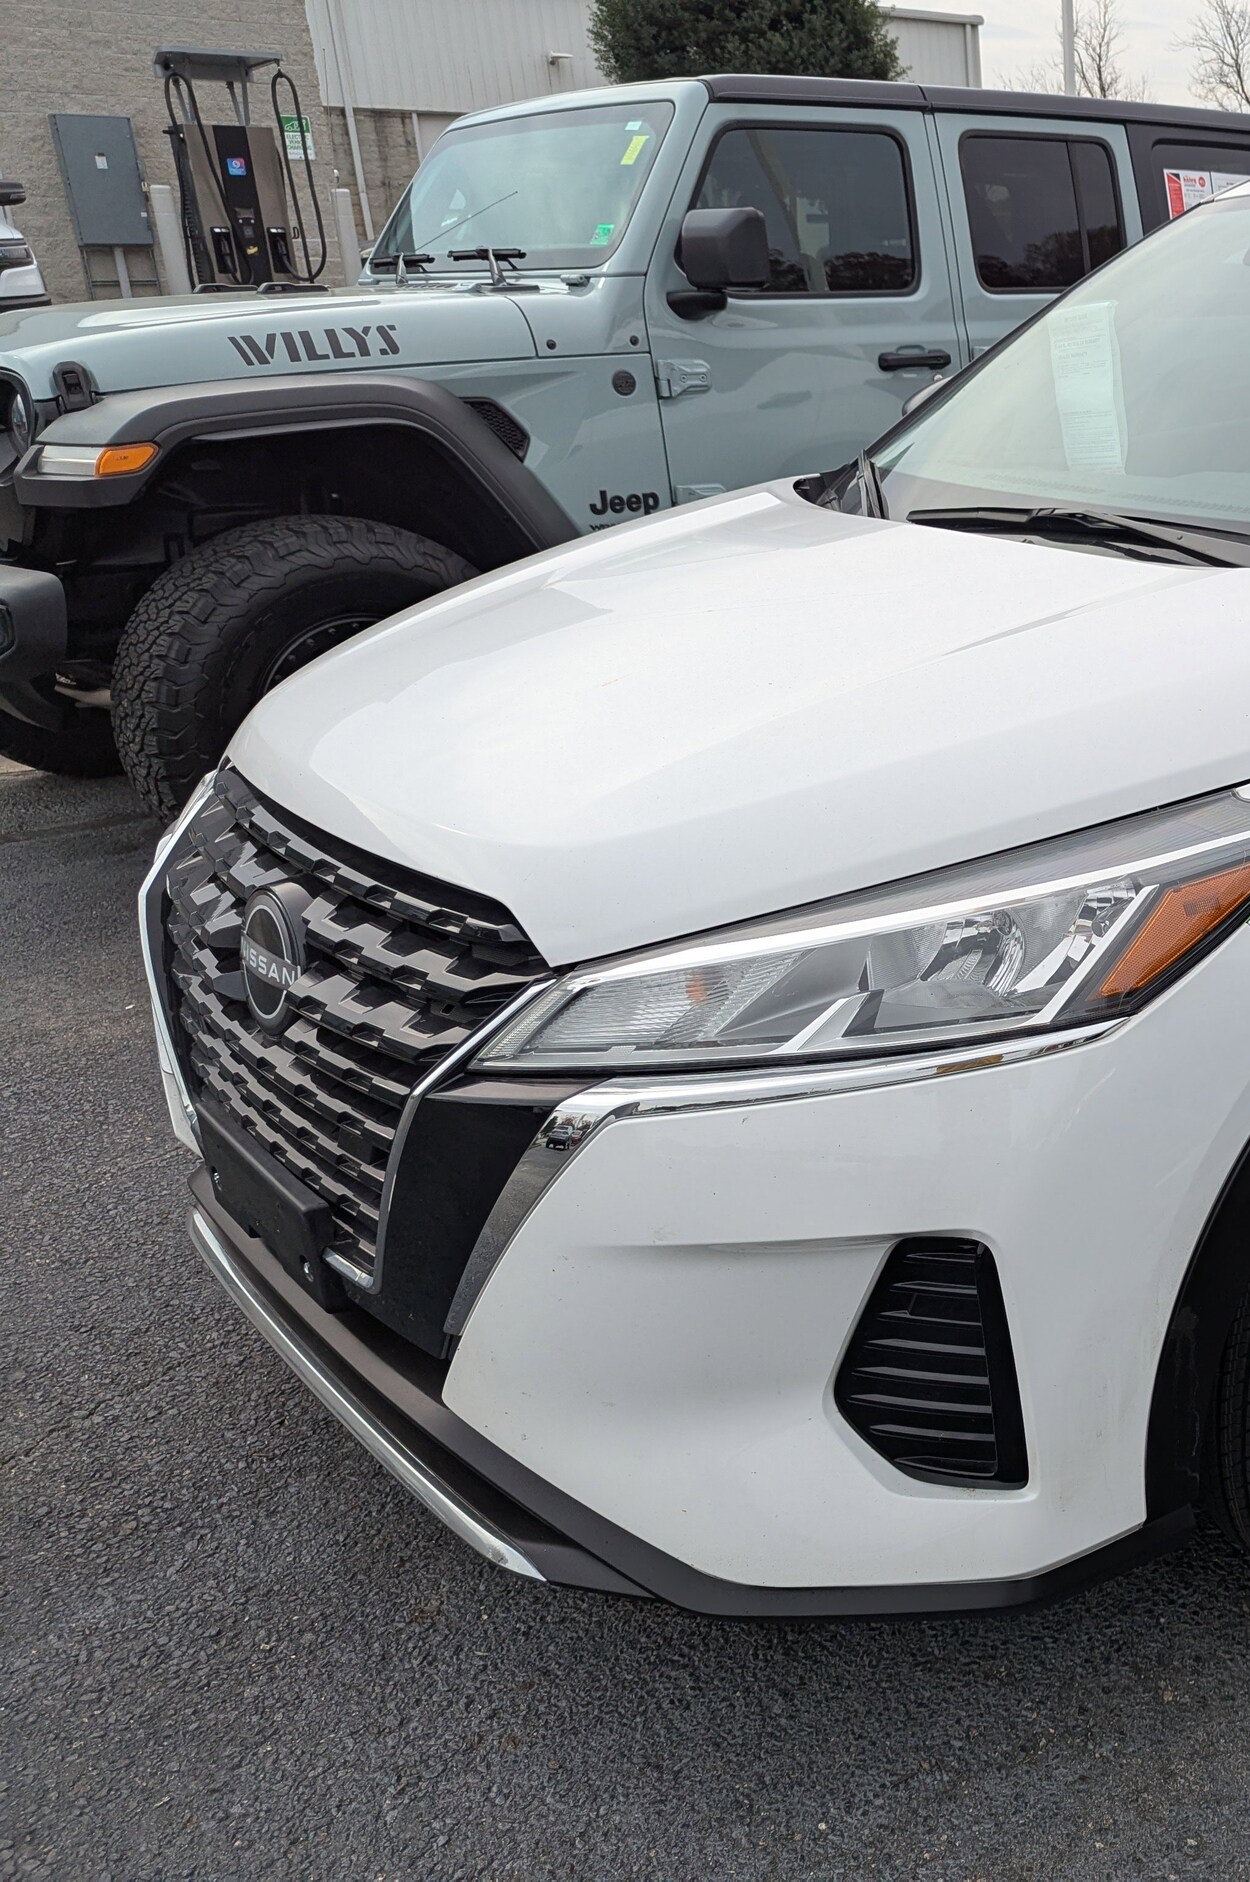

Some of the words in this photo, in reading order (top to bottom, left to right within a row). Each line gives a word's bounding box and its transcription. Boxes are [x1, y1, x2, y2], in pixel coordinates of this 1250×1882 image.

[227, 325, 401, 367] WILLYS
[589, 490, 660, 515] Jeep
[241, 935, 296, 986] NISSAN
